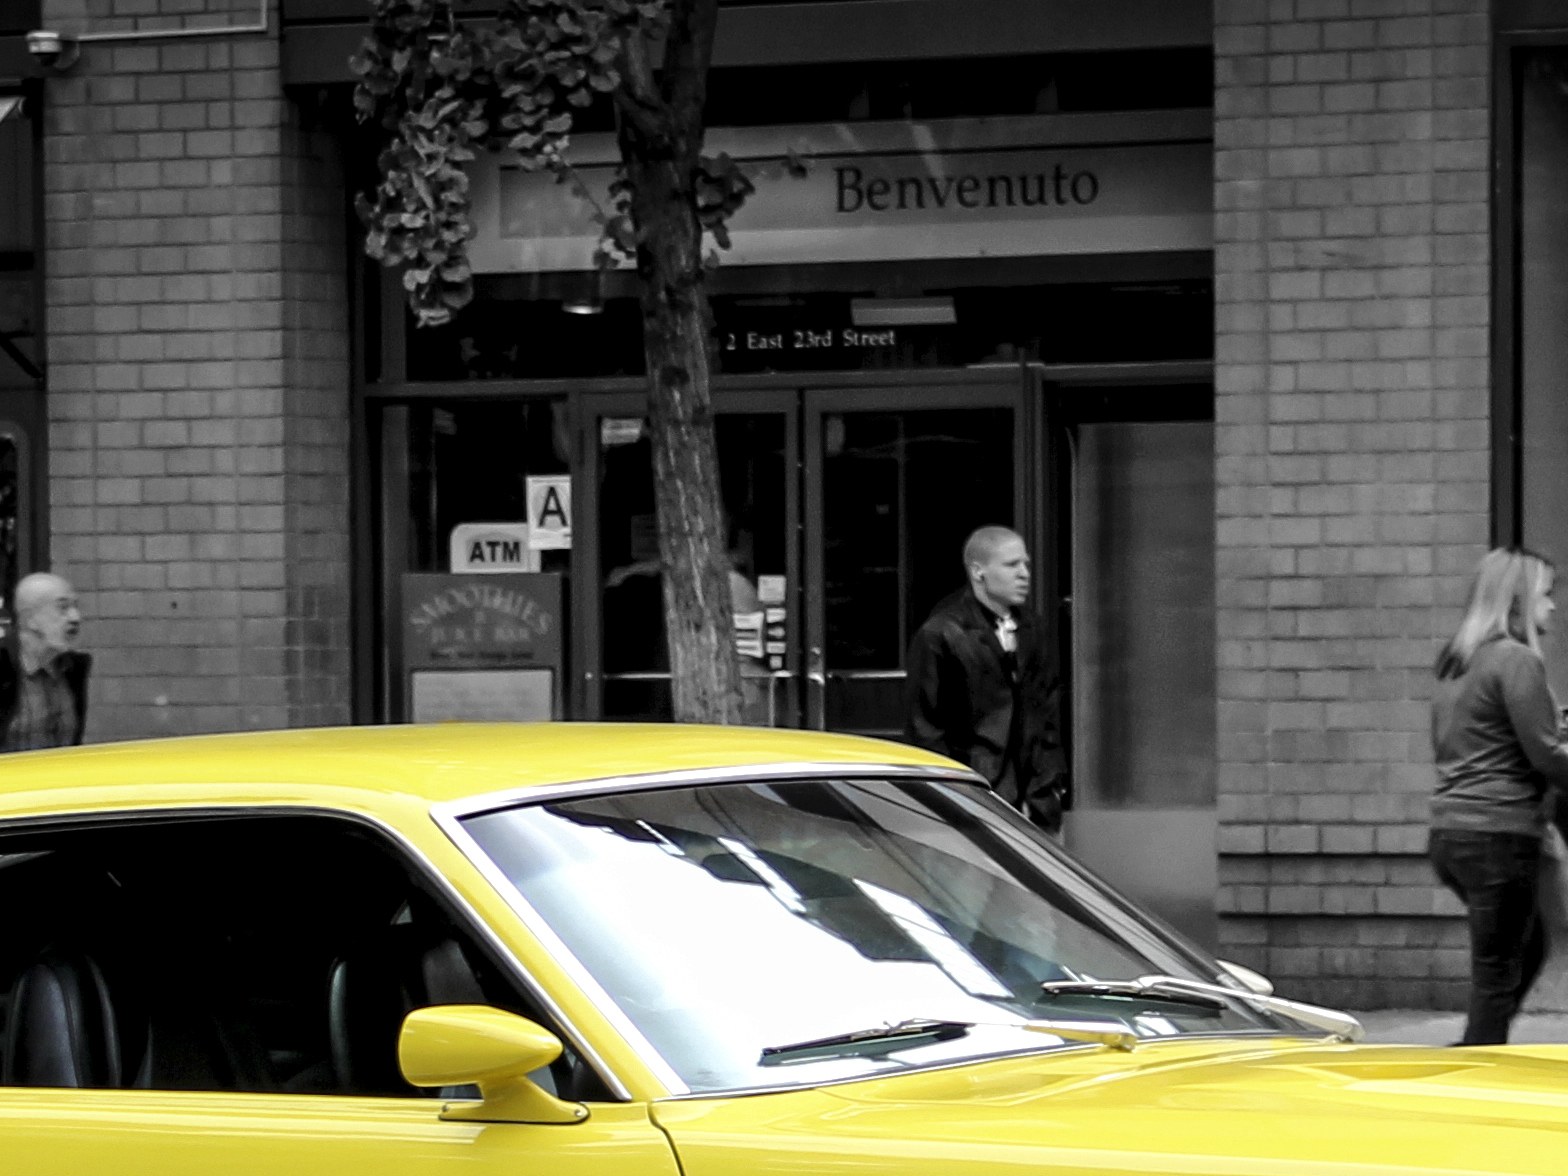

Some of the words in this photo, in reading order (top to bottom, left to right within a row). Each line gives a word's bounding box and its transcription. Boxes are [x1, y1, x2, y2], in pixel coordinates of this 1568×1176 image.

[833, 163, 1100, 213] Benvenuto
[747, 332, 783, 350] East
[793, 329, 833, 349] 23rd
[842, 328, 896, 347] Street
[538, 486, 568, 528] A
[469, 541, 521, 563] ATM
